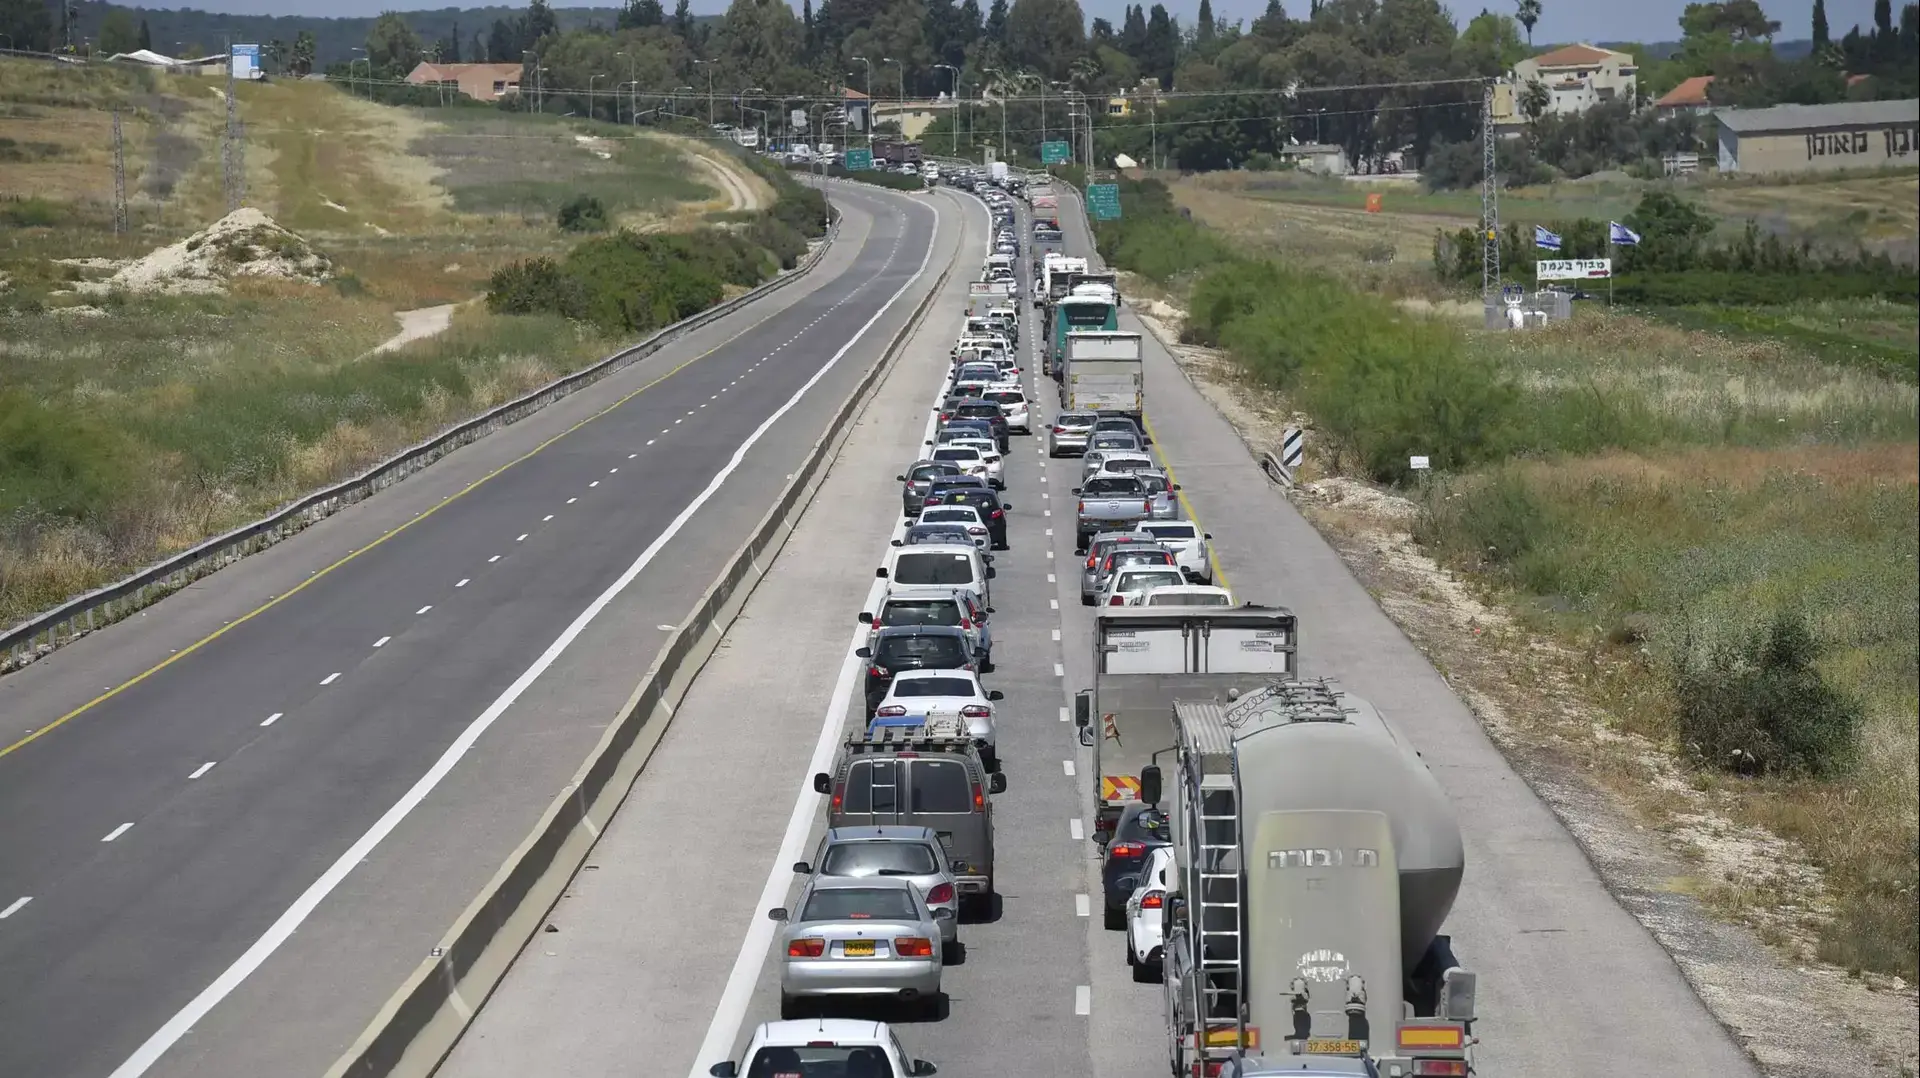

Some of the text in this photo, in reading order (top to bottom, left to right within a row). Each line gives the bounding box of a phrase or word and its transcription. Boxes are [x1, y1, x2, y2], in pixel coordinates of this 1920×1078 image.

[1805, 131, 1868, 161] מאומן
[1540, 260, 1605, 273] מבוך בעמק
